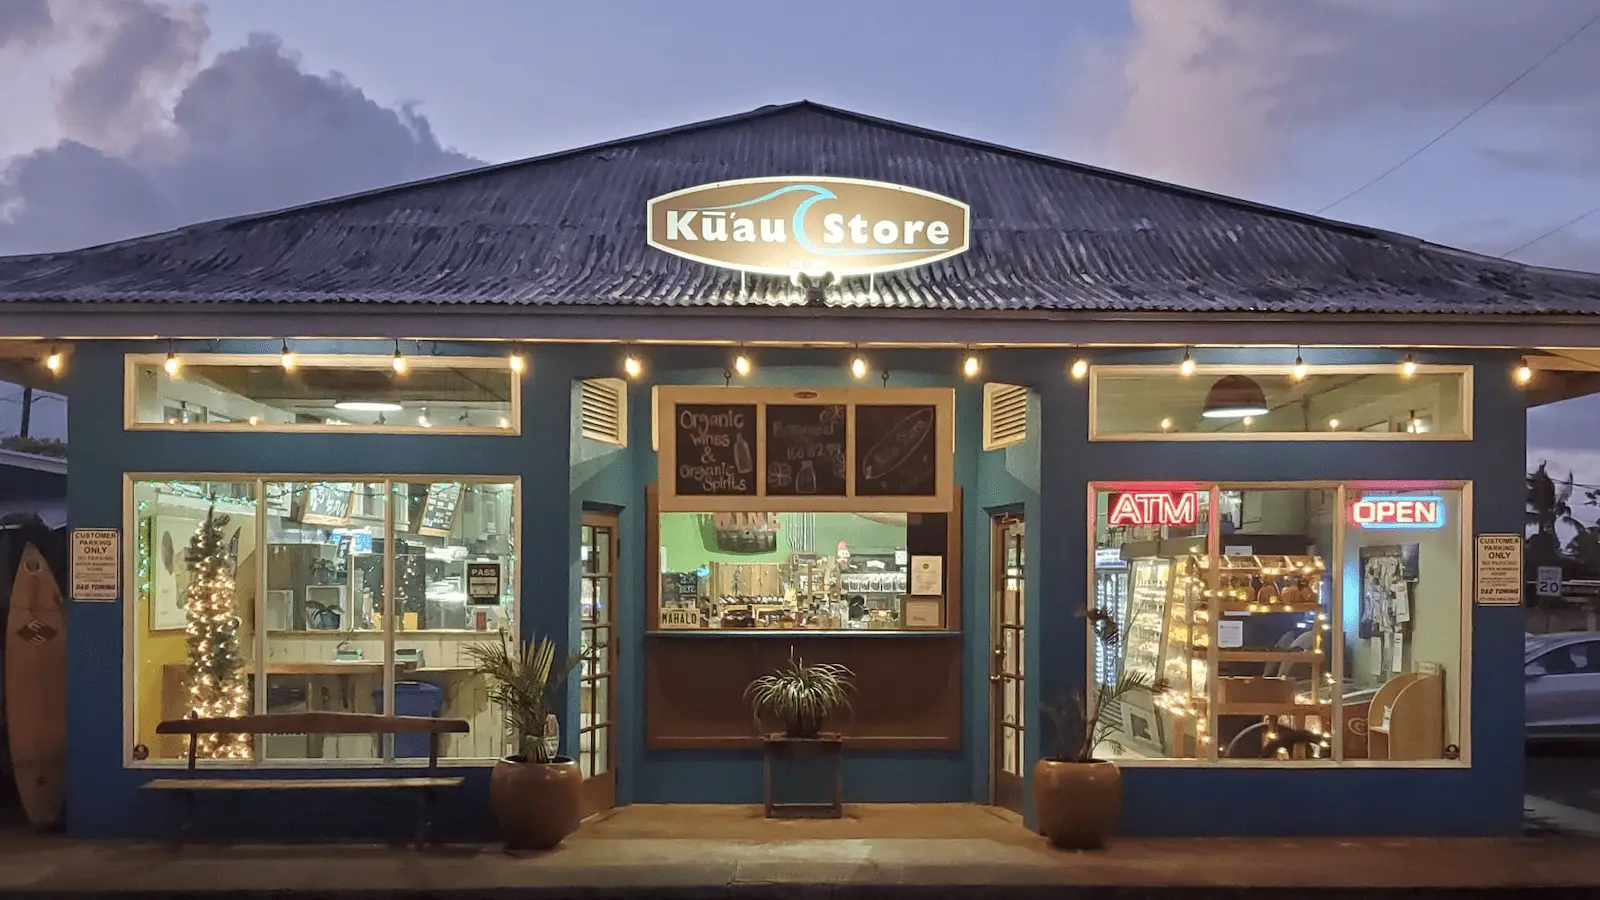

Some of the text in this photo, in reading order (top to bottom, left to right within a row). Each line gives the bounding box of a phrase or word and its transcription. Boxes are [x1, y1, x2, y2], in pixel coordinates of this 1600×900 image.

[823, 213, 950, 245] Store
[680, 410, 745, 435] Organic
[701, 446, 716, 463] &
[1110, 492, 1195, 524] ATM
[1352, 501, 1437, 524] OPEN
[83, 546, 108, 554] ONLY
[1488, 551, 1511, 559] ONLY
[471, 569, 496, 577] PASS
[1539, 581, 1559, 593] 20
[661, 612, 697, 625] MAHALO
